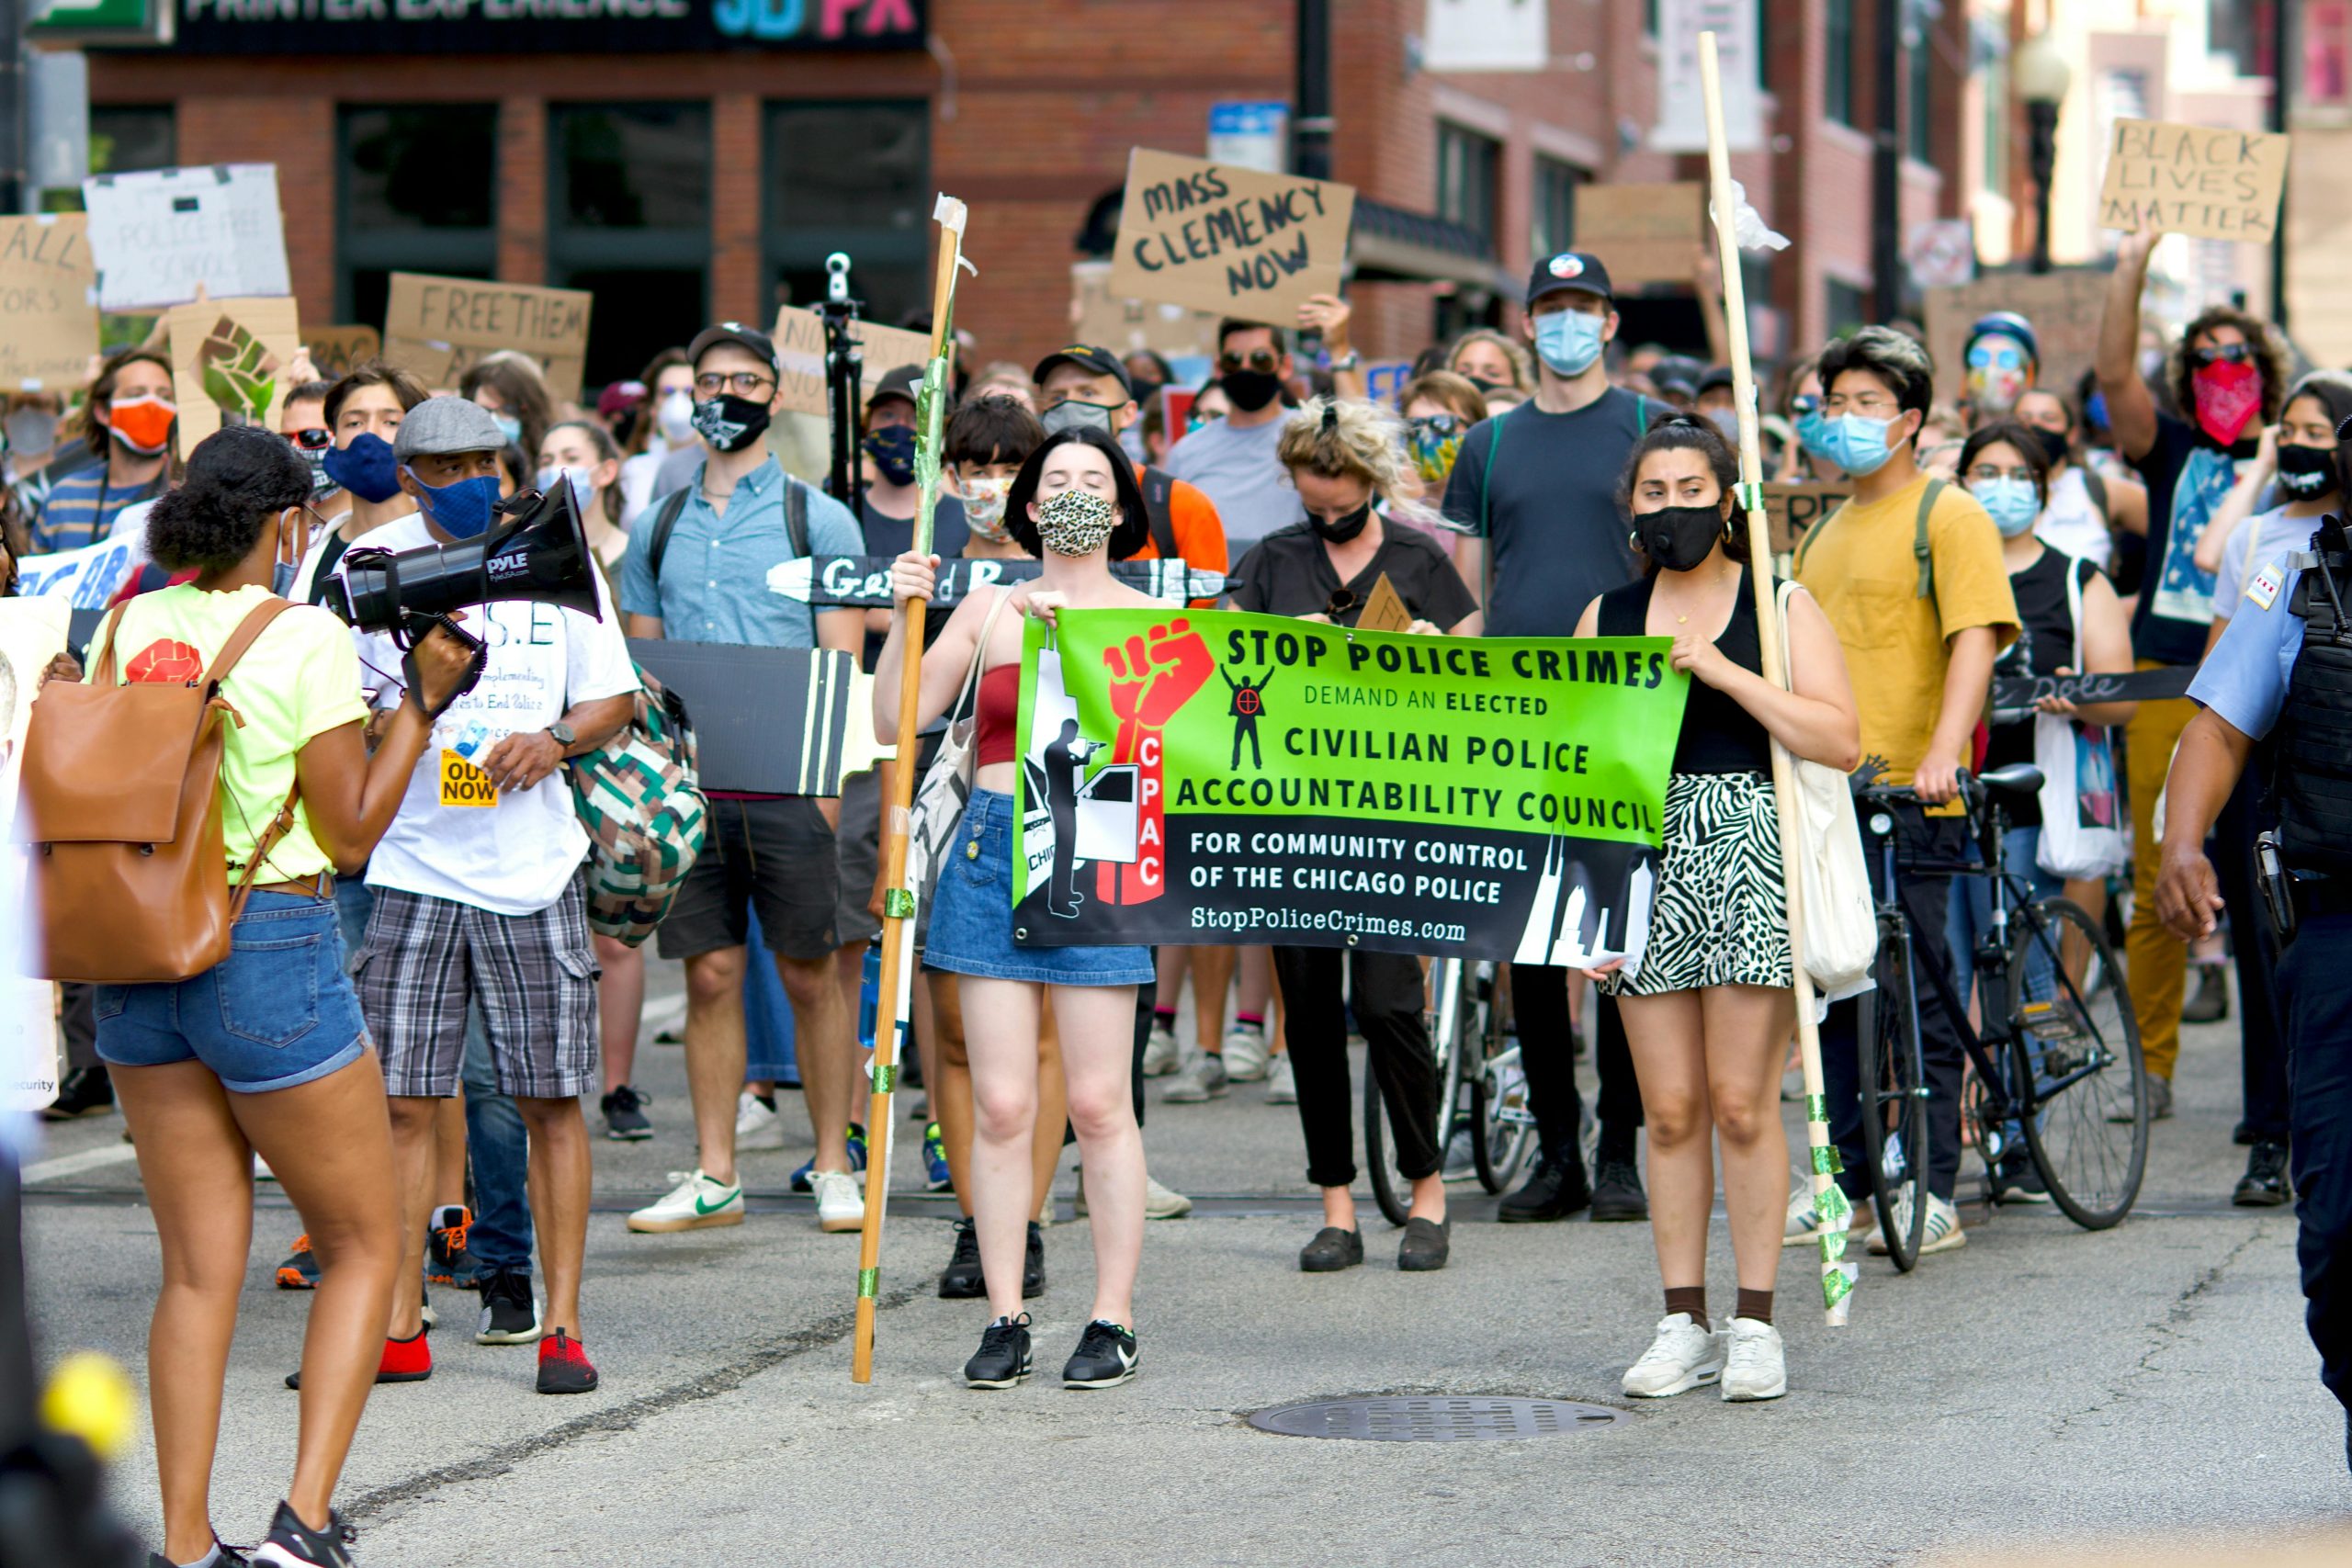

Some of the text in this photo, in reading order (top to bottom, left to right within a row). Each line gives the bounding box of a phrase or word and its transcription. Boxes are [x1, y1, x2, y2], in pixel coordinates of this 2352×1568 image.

[2116, 125, 2265, 166] BLACK
[1142, 167, 1229, 221] MASS
[2120, 161, 2258, 202] LIVES
[1133, 183, 1325, 272] CLEMENCY
[2104, 197, 2270, 231] MATTER
[3, 223, 78, 269] ALL
[1226, 231, 1309, 297] NOW
[0, 288, 61, 314] ORS
[420, 286, 584, 339] FREE THEM
[485, 551, 529, 574] PYLE
[1227, 628, 1665, 690] STOP POLICE CRIMES
[487, 693, 510, 709] End
[1304, 684, 1548, 716] DEMAND AN ELECTED
[1283, 727, 1589, 775] CIVILIAN POLICE
[443, 781, 496, 801] NOW
[1175, 777, 1657, 834] ACCOUNTABILITY COUNCIL
[1190, 831, 1529, 872] FOR COMMUNITY CONTROL
[1189, 865, 1502, 904] OF THE CHICAGO POLICE
[1191, 906, 1467, 942] StopPoliceCrimes.com
[13, 1078, 54, 1092] ecurity
